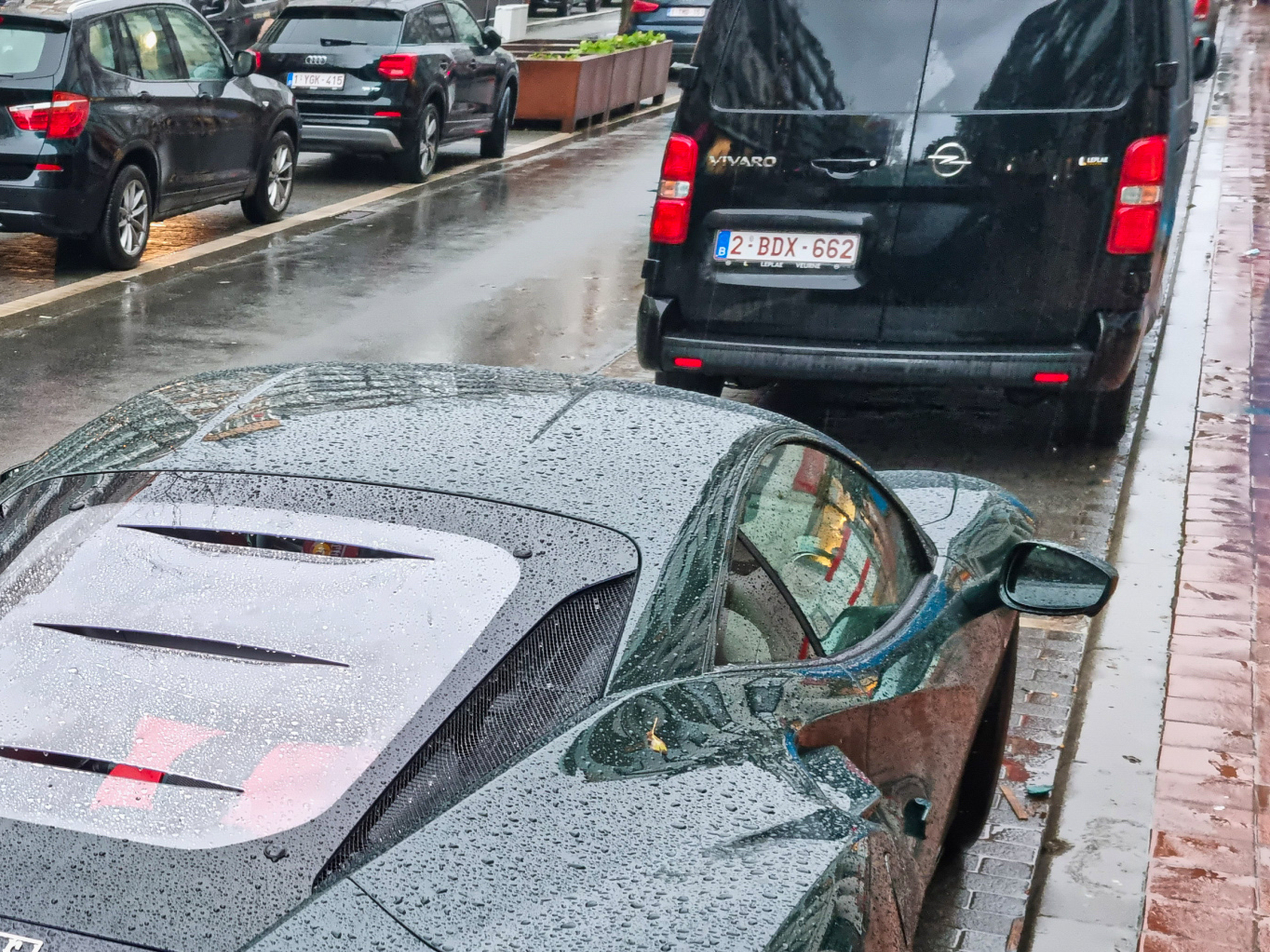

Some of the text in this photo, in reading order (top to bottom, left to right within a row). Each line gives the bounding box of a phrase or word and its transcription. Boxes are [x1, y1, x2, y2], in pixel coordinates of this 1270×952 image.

[294, 75, 343, 85] 1-YGK-415
[709, 155, 777, 168] VIVARO
[718, 235, 854, 260] B 2-BDX-662
